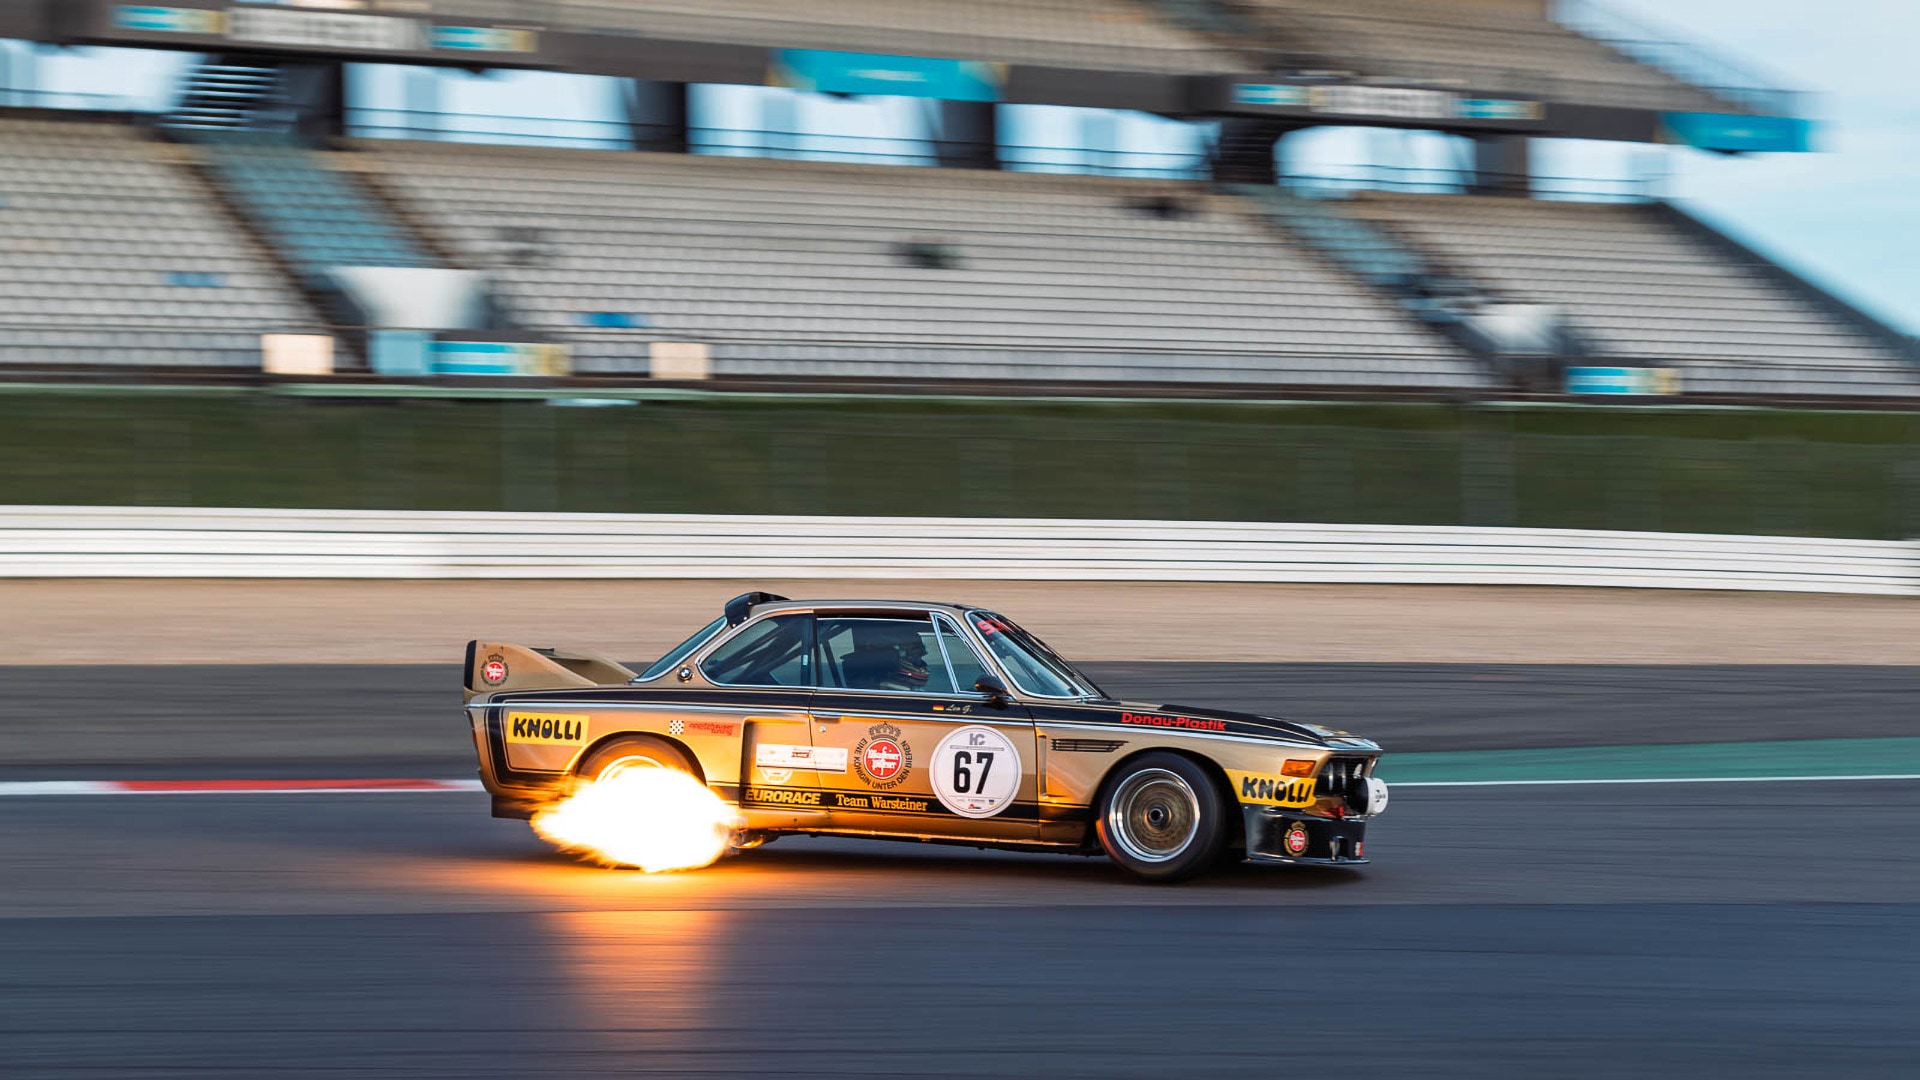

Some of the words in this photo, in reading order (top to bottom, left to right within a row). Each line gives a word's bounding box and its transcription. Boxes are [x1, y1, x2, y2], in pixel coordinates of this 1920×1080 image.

[513, 717, 582, 740] KNOLLI
[1121, 712, 1226, 731] Donau-Plastik
[854, 738, 867, 755] EINE
[872, 780, 898, 789] UNTER
[896, 768, 910, 784] DEN
[953, 751, 994, 795] 67
[745, 789, 821, 805] EURORACE
[1242, 776, 1313, 803] KNOLLI
[836, 794, 868, 807] Team
[871, 795, 928, 811] Warsteiner
